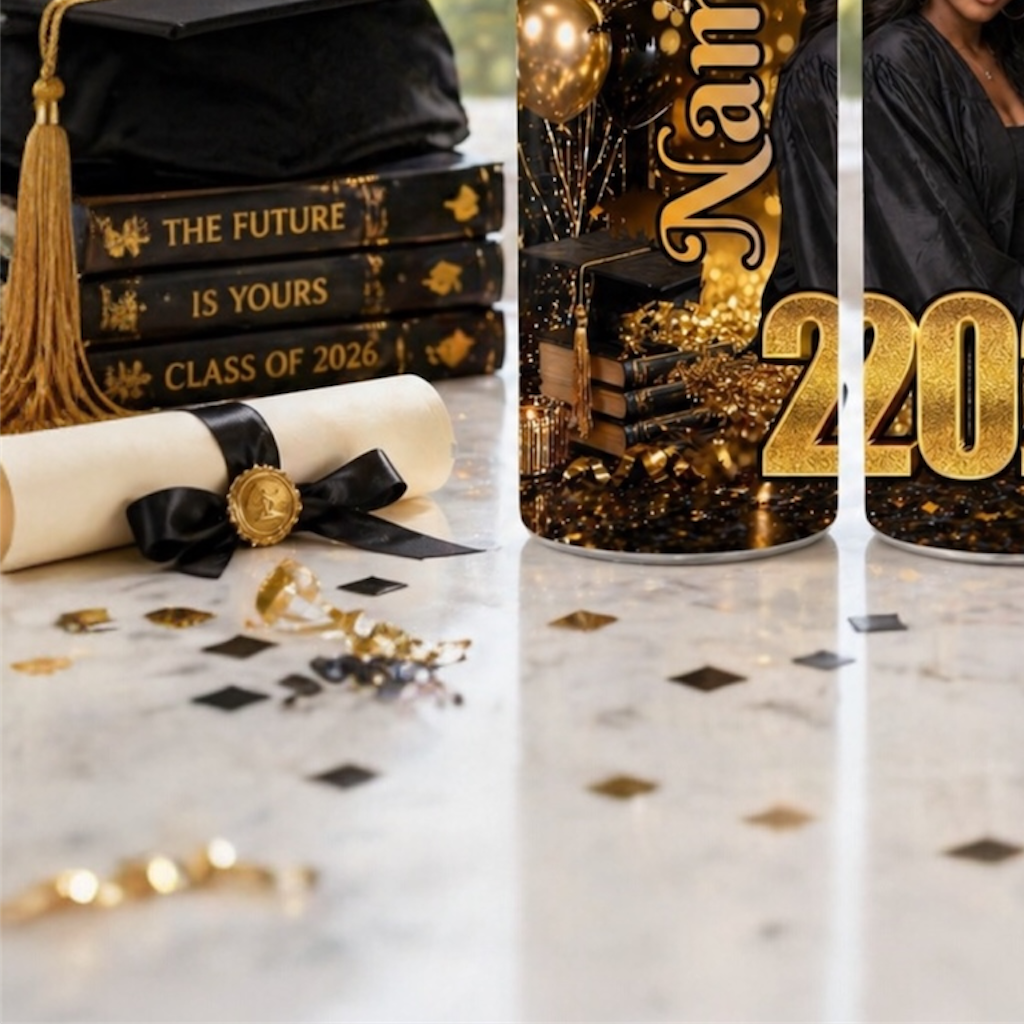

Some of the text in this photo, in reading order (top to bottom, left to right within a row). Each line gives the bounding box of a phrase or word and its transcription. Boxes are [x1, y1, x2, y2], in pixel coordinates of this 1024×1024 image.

[162, 202, 346, 247] THE FUTURE
[192, 278, 328, 318] IS YOURS
[164, 340, 379, 391] CLASS OF 2026
